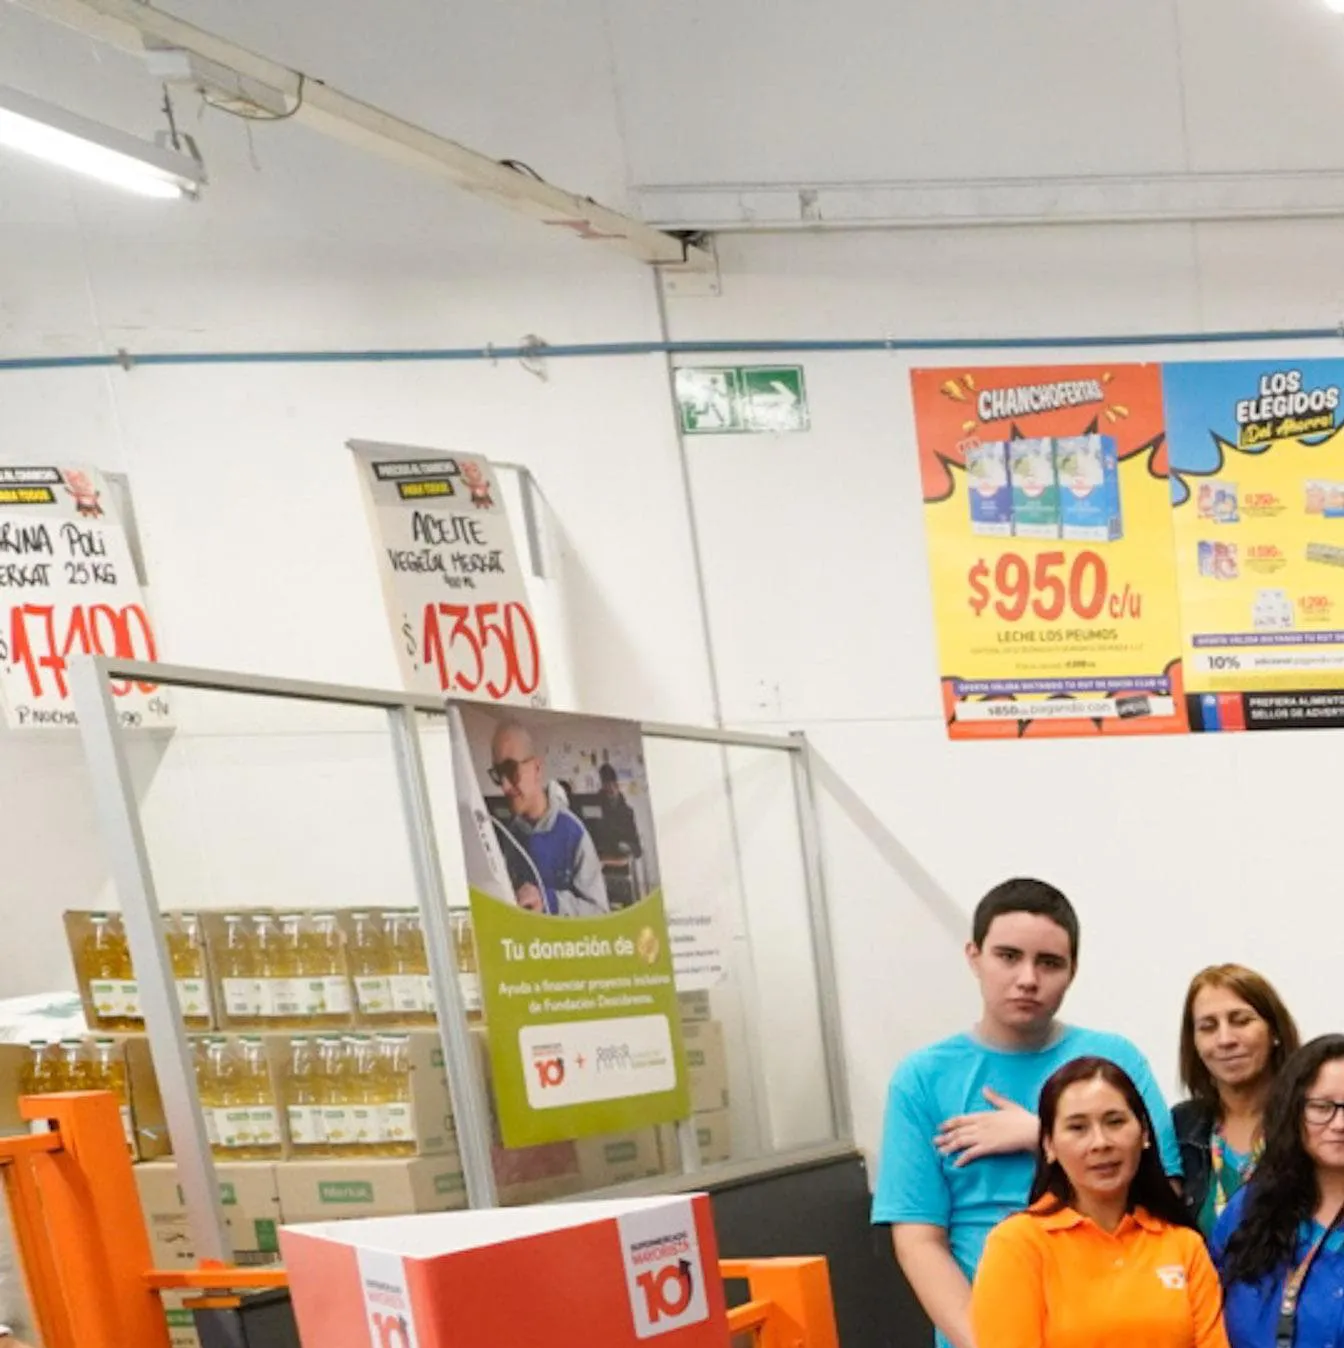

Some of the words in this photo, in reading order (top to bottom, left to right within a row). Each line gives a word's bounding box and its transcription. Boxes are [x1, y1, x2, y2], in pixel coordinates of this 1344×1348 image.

[1261, 370, 1301, 395] LOS
[977, 379, 1104, 422] CHANCHOFERTAS
[1236, 388, 1338, 422] ELEGIDOS
[412, 511, 487, 545] ACEITE
[968, 550, 1108, 622] $950
[997, 630, 1036, 643] LECHE
[1039, 629, 1064, 642] LOS
[1208, 655, 1241, 669] 10%
[500, 938, 525, 961] Tu
[528, 936, 612, 961] donación
[615, 938, 634, 956] de
[534, 1057, 565, 1089] 10
[636, 1261, 693, 1324] 10
